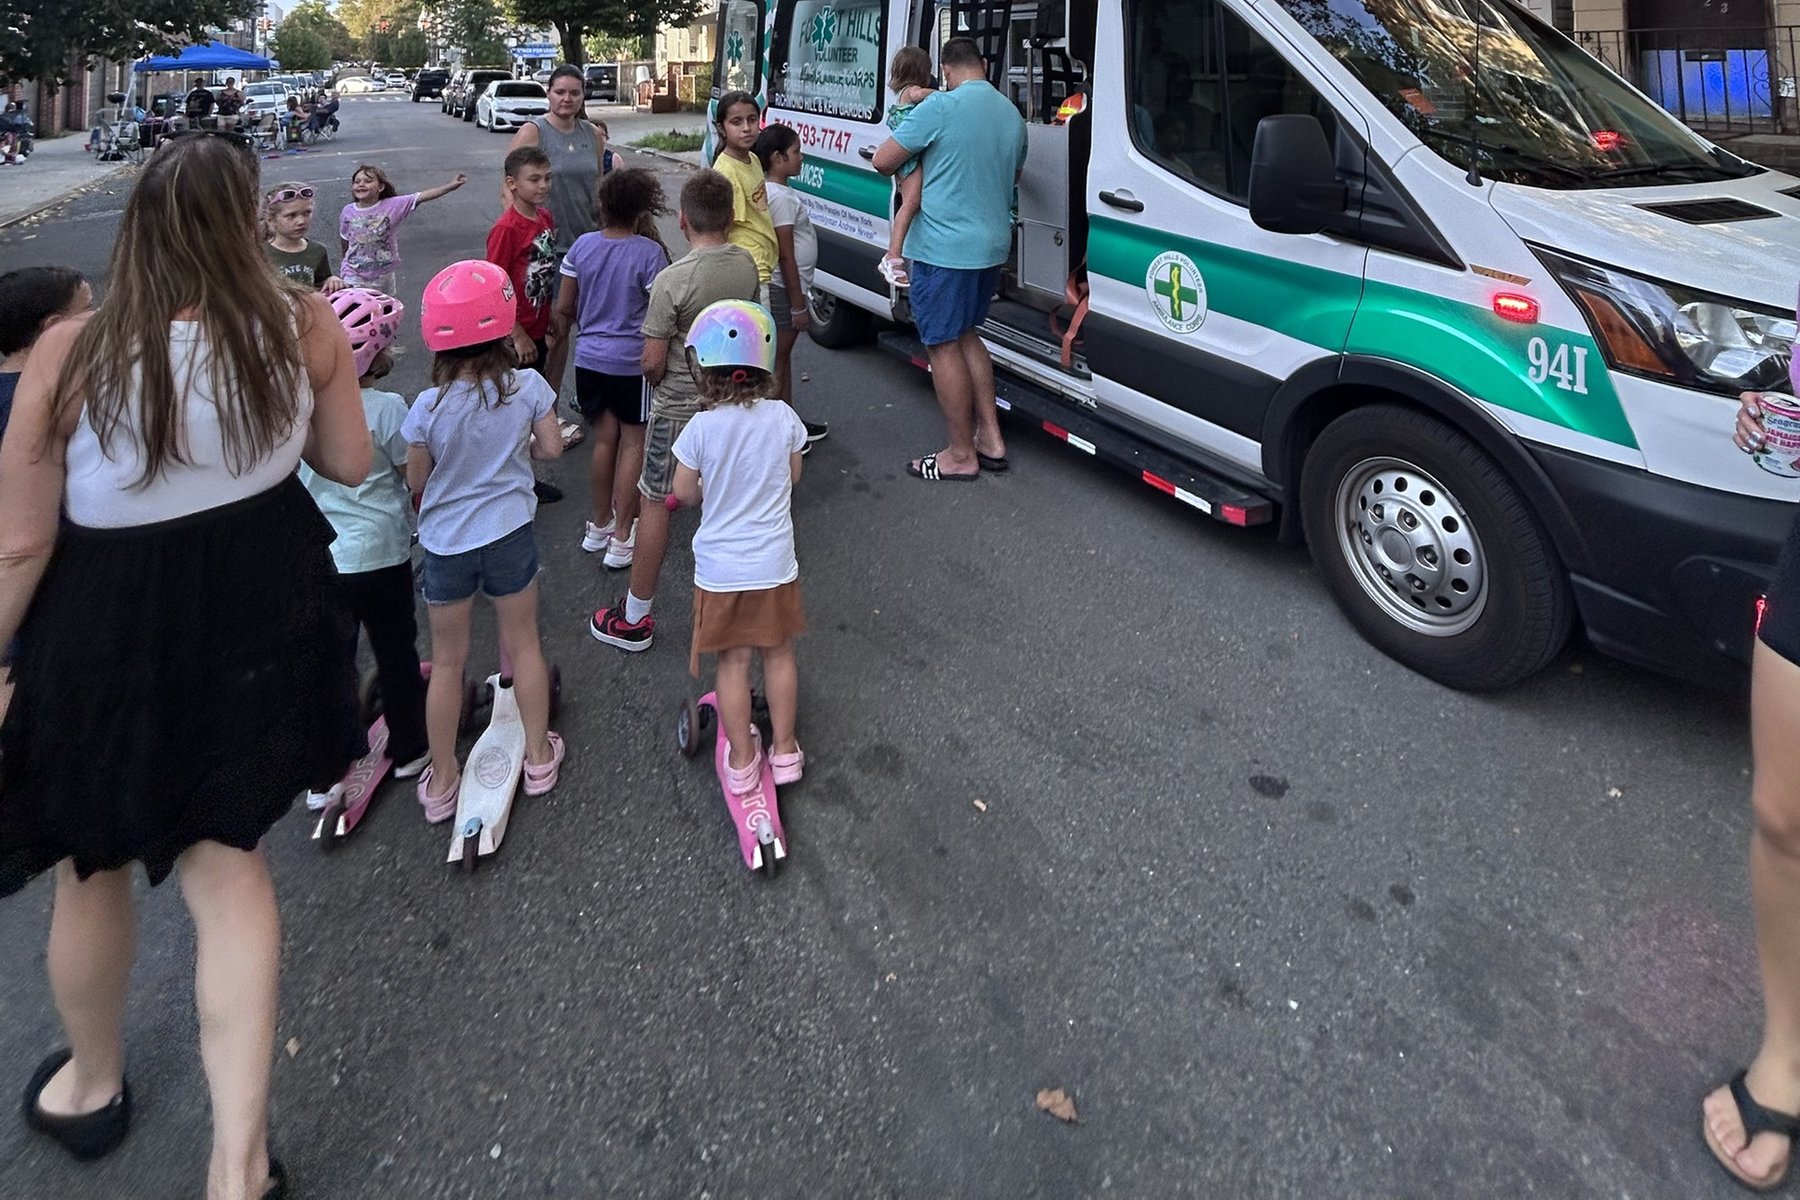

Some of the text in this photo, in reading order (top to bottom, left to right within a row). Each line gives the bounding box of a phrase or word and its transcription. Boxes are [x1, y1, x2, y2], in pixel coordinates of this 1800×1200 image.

[814, 47, 858, 63] VOLUNTEER
[794, 162, 824, 189] VICES
[1149, 257, 1163, 280] FOREST
[1180, 257, 1203, 293] VOLUNTEER
[1152, 300, 1203, 331] AMBULANCE CORPS
